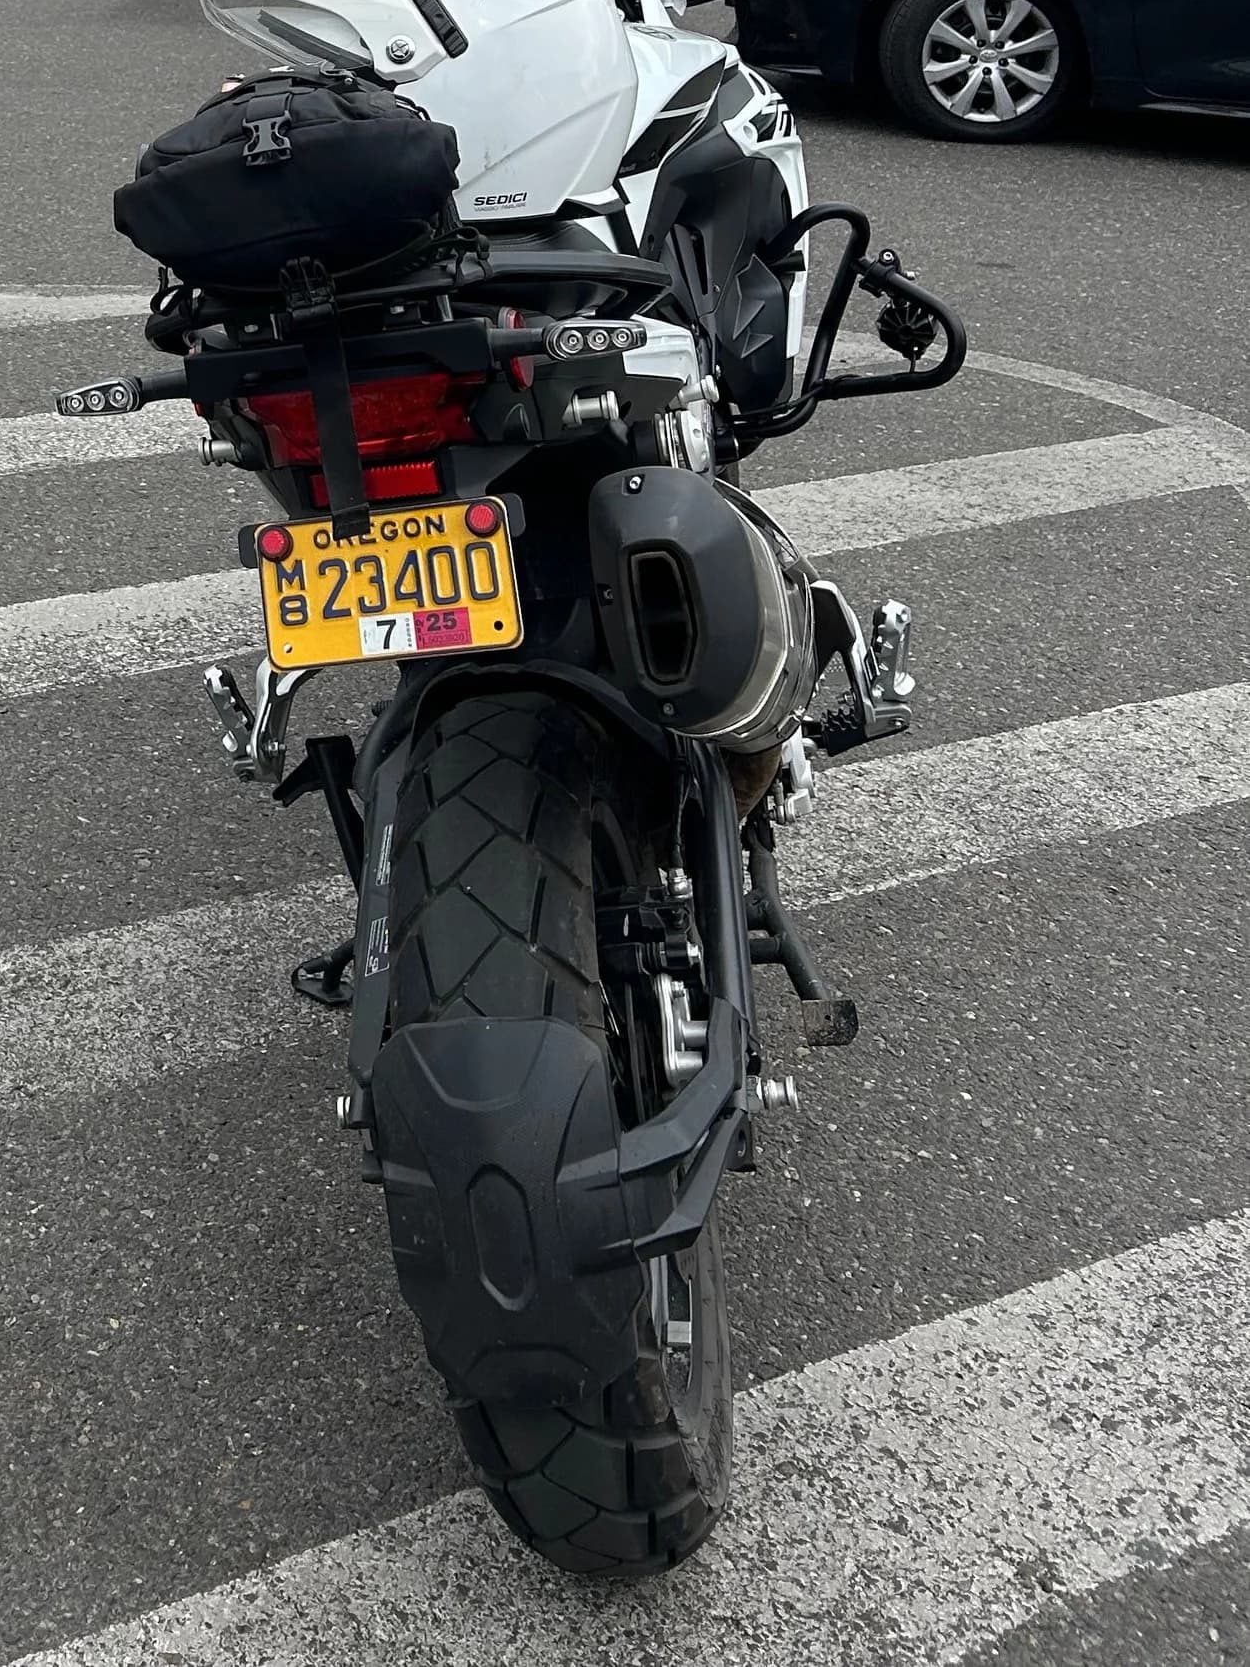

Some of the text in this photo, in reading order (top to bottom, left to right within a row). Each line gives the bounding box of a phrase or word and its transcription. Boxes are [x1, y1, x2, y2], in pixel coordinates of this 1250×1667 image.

[473, 191, 528, 206] SEDICI
[313, 514, 446, 550] OGON
[376, 619, 397, 650] 7
[425, 611, 458, 632] 25
